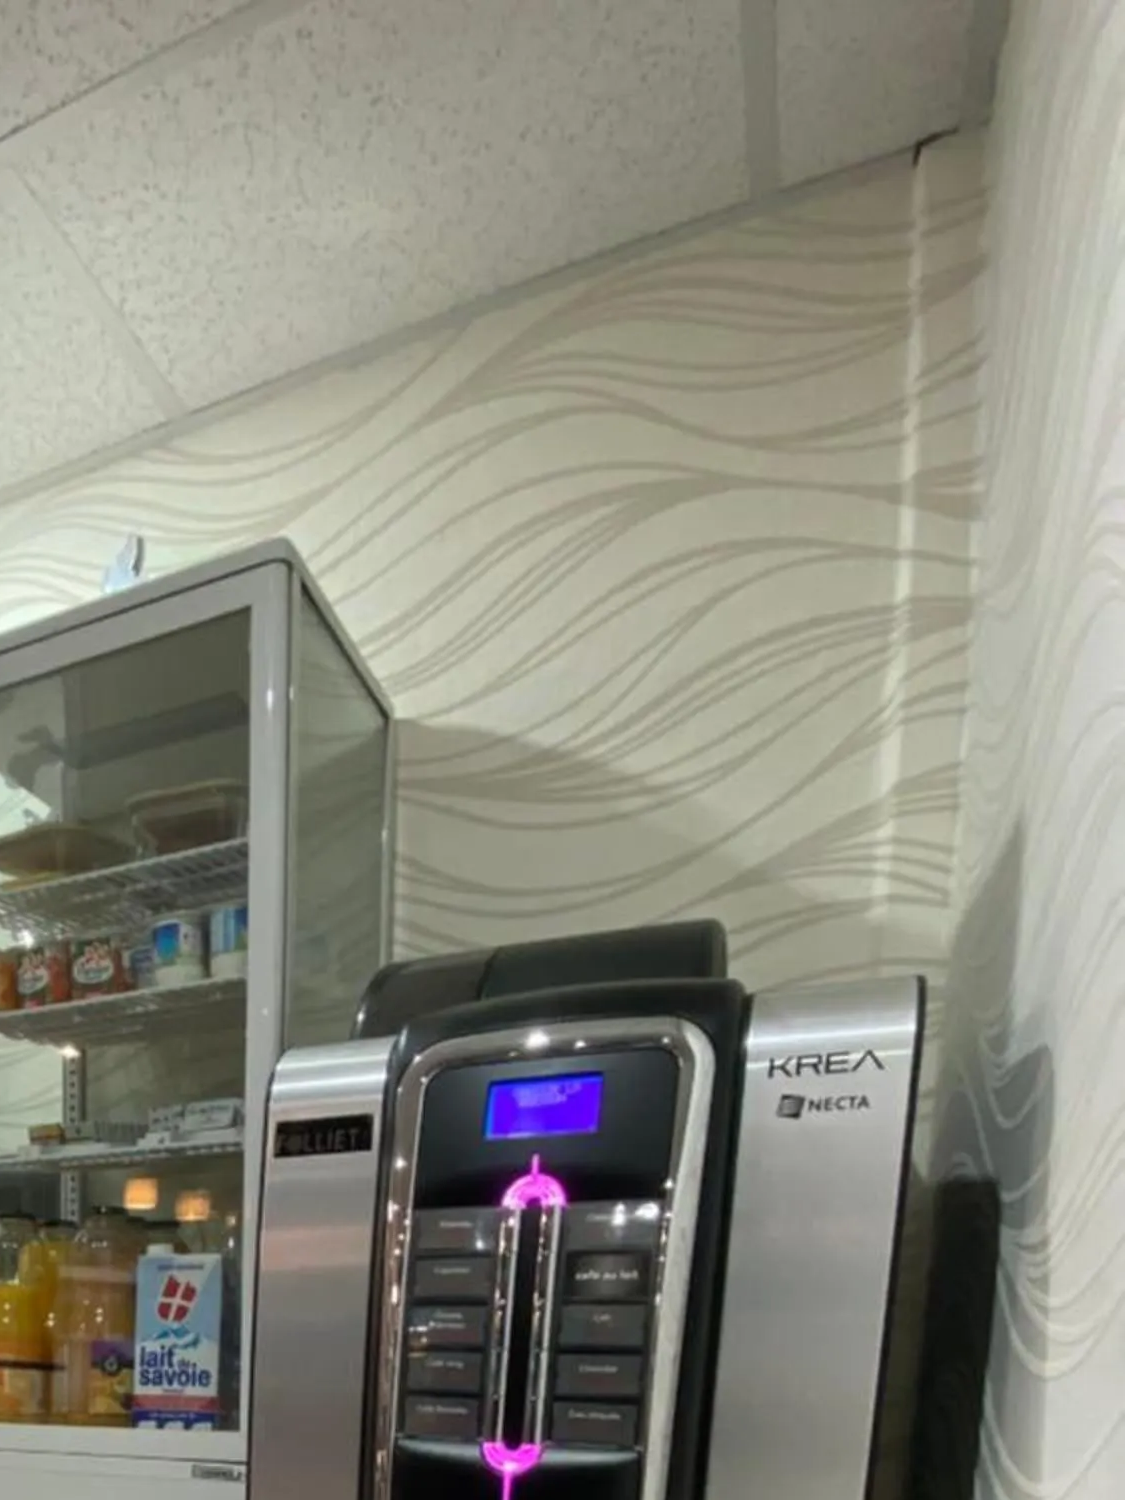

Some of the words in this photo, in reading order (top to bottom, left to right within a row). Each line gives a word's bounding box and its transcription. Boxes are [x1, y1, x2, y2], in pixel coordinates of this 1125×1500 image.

[768, 1050, 884, 1078] KREA
[807, 1095, 871, 1112] NECTA
[140, 1345, 174, 1368] lait
[139, 1363, 211, 1388] savoie
